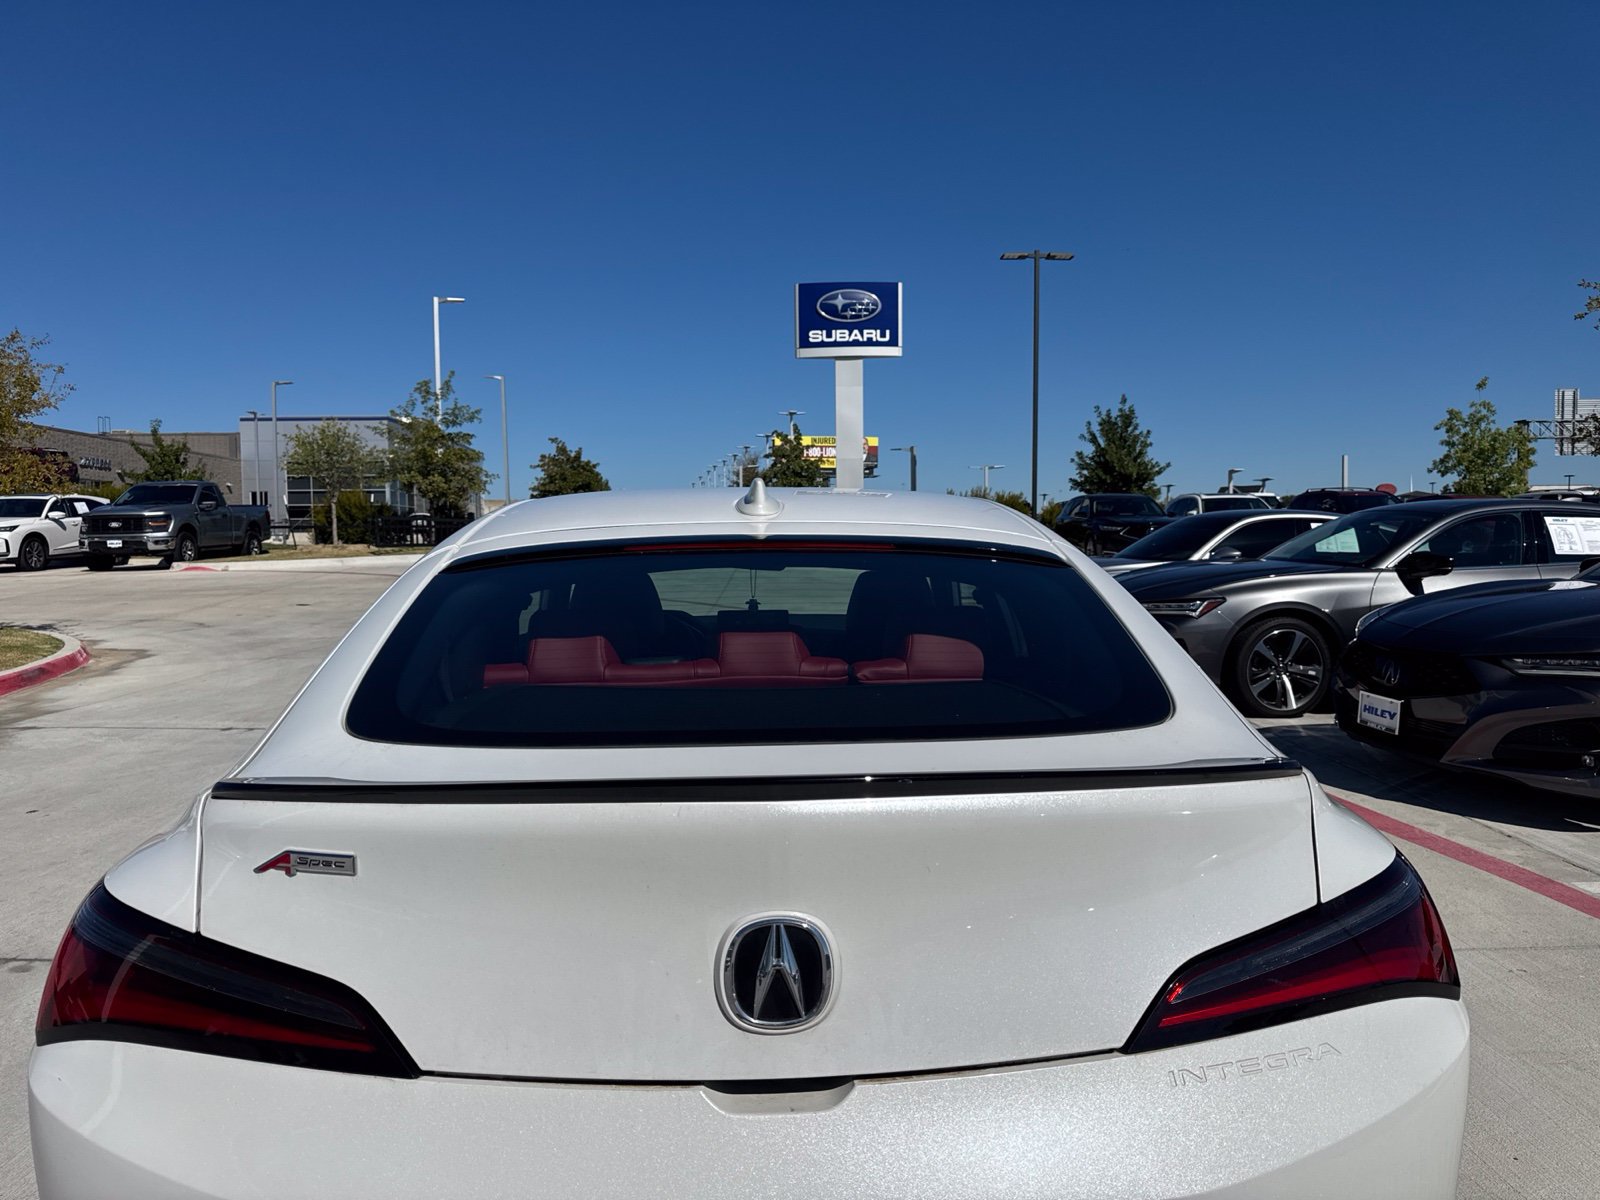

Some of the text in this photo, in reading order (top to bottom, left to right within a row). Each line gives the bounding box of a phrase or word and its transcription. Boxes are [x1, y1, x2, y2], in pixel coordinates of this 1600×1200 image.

[808, 329, 890, 342] SUBARU
[1363, 704, 1398, 720] HILEY
[1168, 1042, 1342, 1087] INTEGRA
